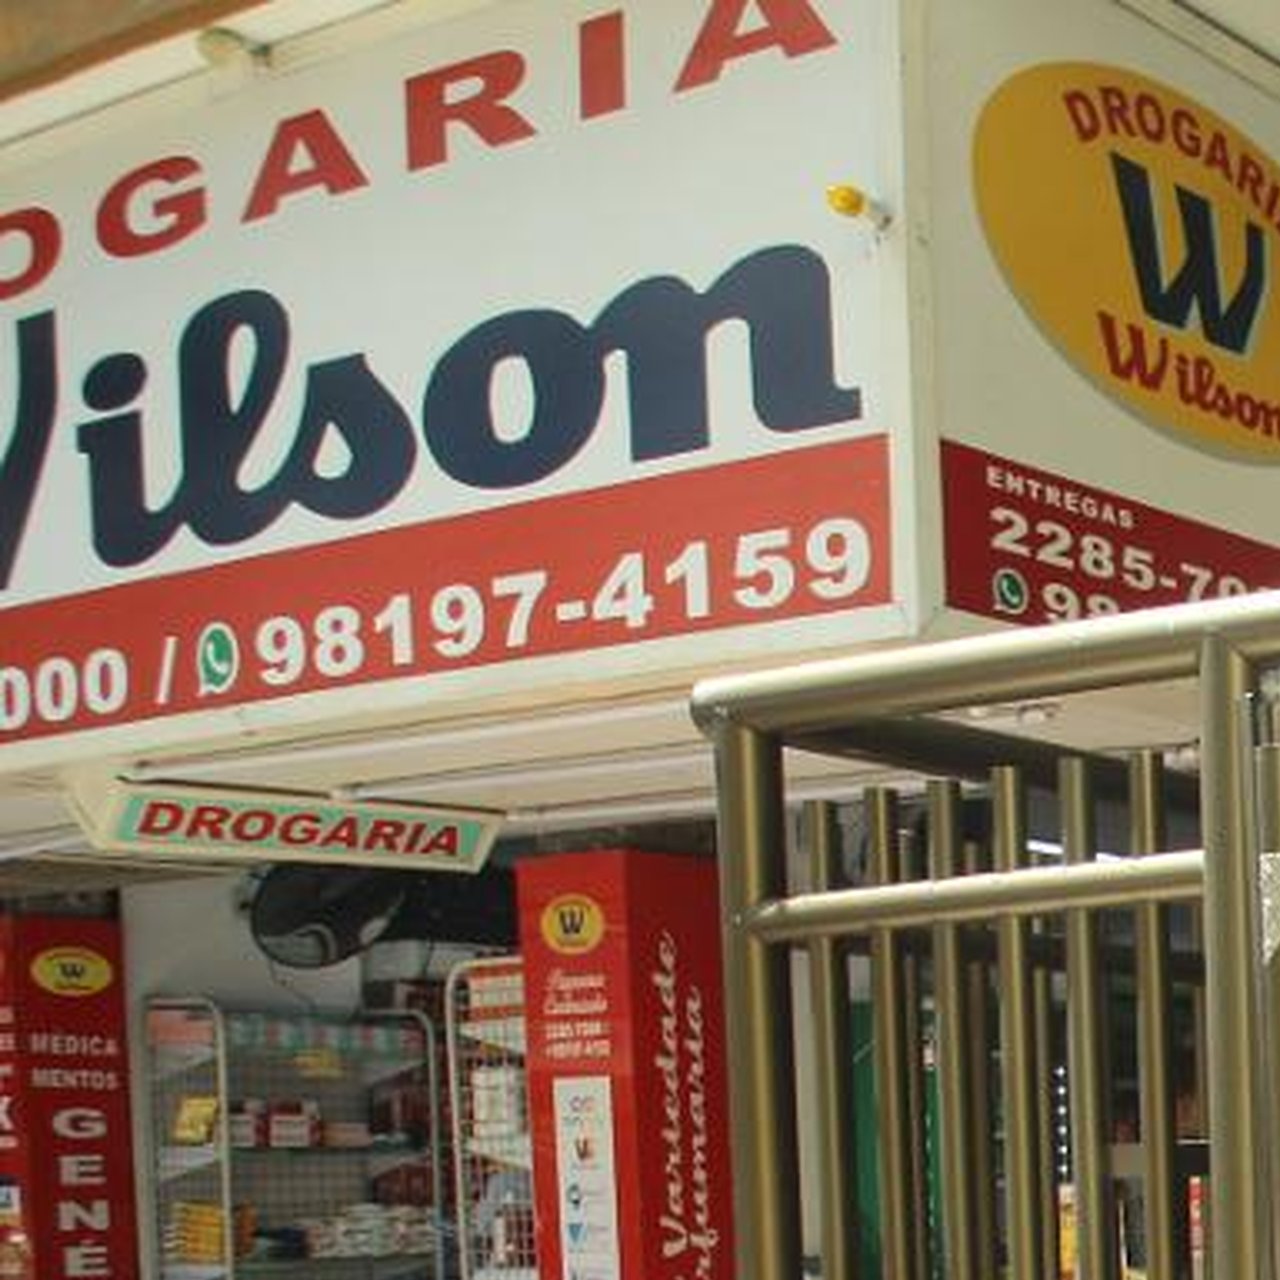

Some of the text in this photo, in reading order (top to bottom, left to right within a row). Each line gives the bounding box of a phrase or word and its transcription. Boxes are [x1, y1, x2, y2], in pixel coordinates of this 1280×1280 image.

[1111, 151, 1268, 354] W
[986, 465, 1136, 529] ENTREGAS
[256, 517, 871, 686] 98197-4159
[135, 801, 462, 858] DROGARIA
[558, 907, 585, 935] W
[31, 1067, 119, 1091] MENTOS
[653, 930, 689, 1258] Variedade
